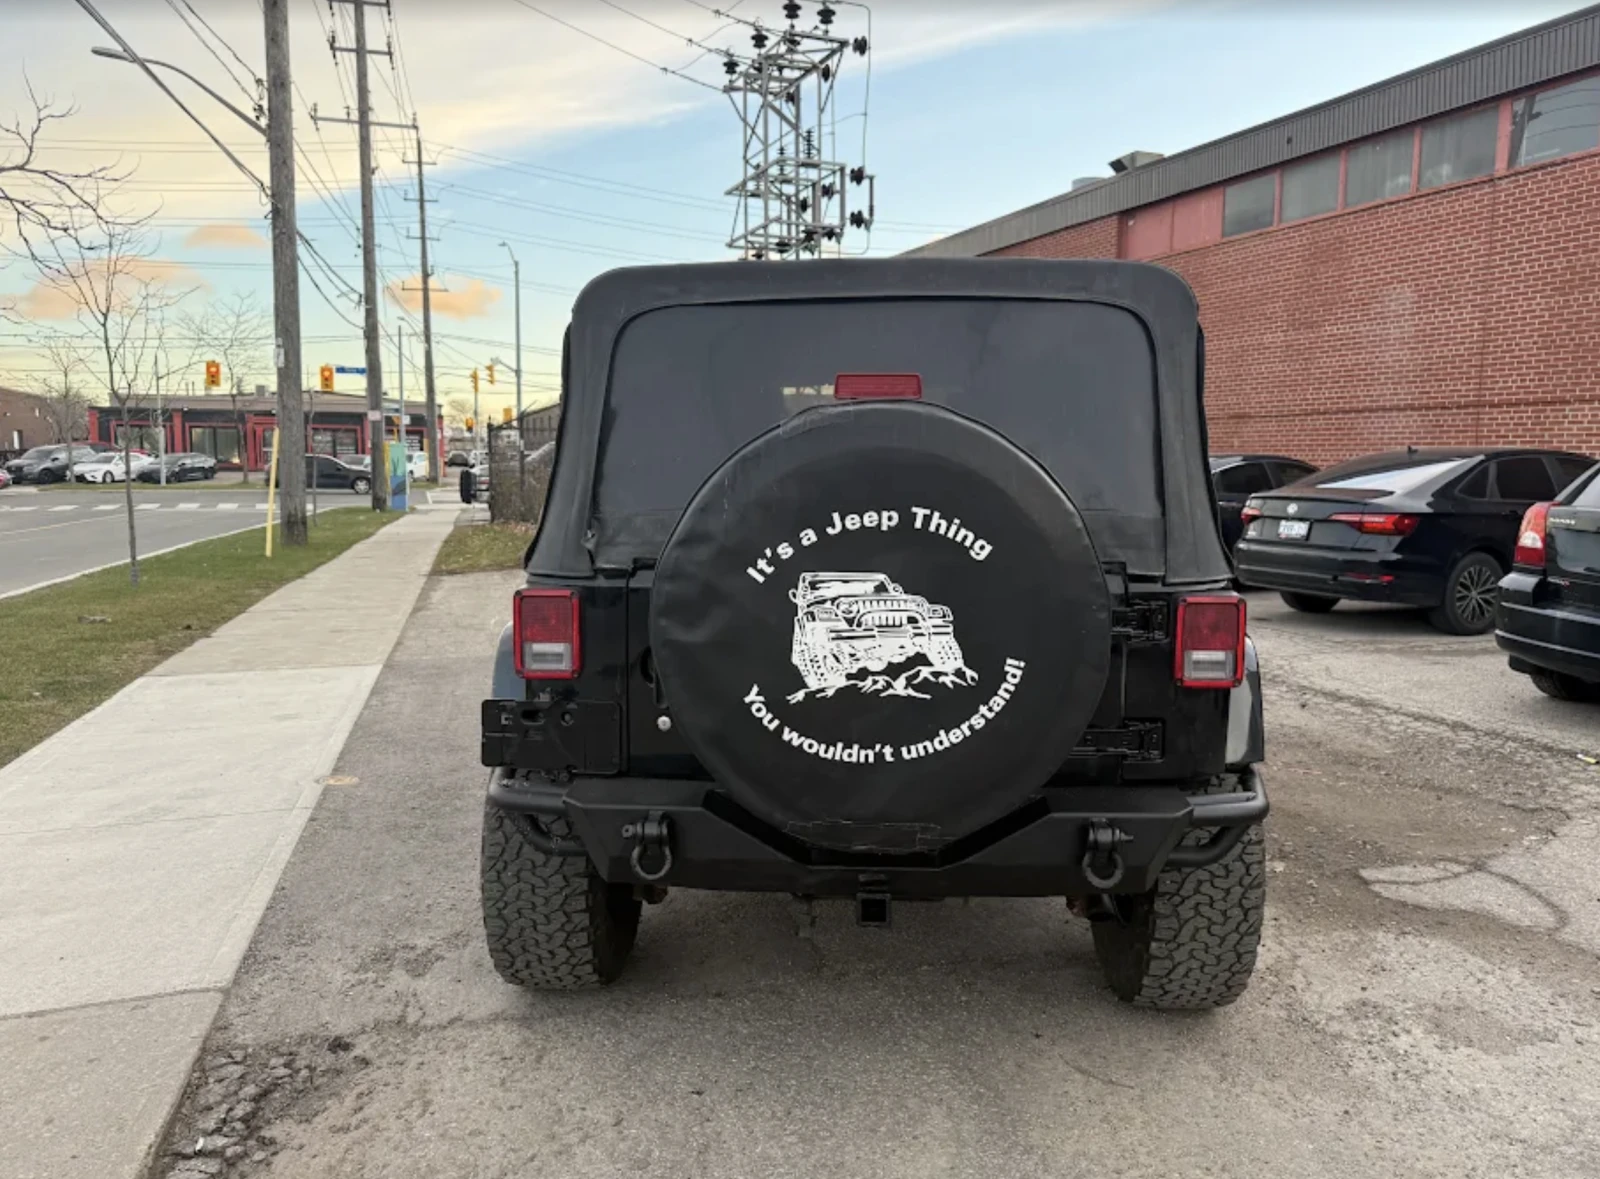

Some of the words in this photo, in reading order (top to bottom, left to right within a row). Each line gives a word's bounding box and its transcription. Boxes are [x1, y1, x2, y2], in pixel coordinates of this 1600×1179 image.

[746, 542, 795, 584] It's
[799, 528, 818, 547] a
[825, 510, 900, 536] Jeep
[910, 506, 993, 561] Thing
[743, 683, 781, 731] You
[781, 725, 895, 764] wouldn't
[900, 657, 1026, 760] understand!
